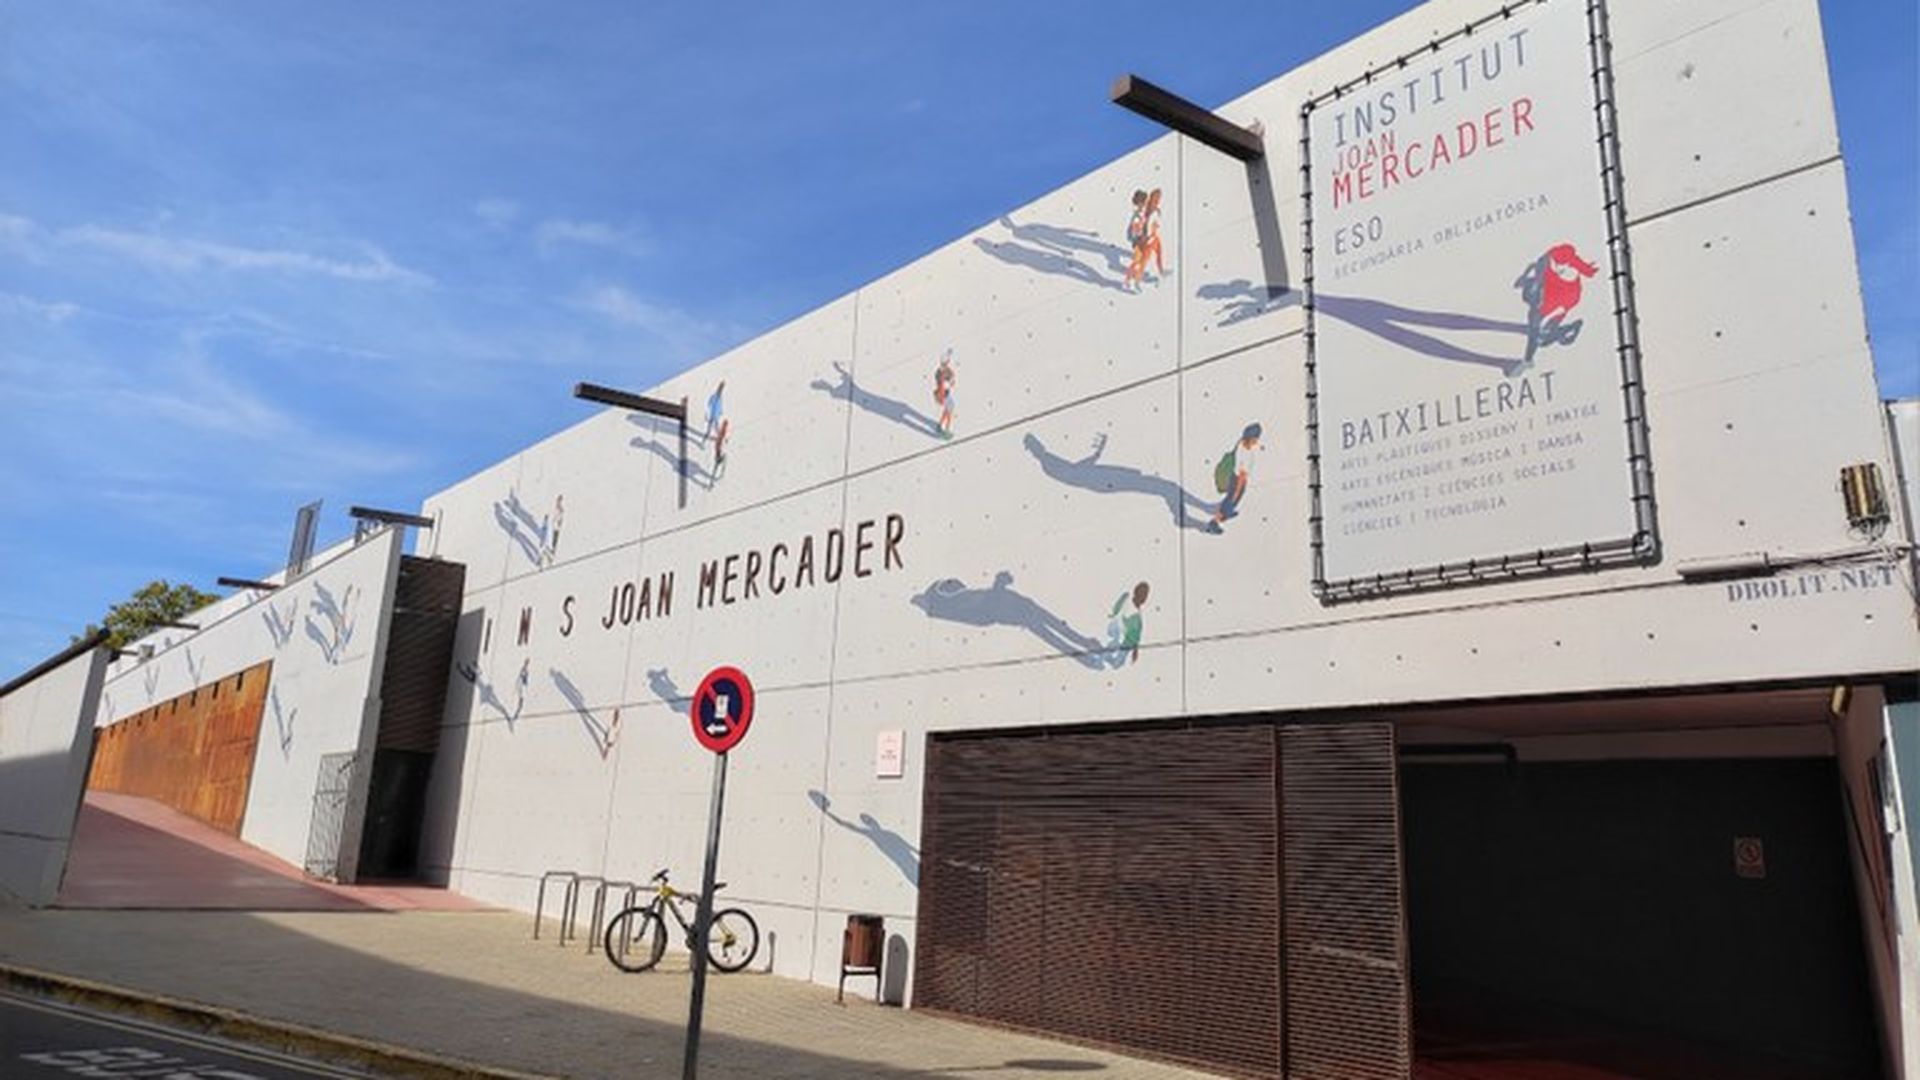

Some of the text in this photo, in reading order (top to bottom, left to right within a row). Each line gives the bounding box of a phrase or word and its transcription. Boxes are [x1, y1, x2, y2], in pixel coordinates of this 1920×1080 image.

[1334, 29, 1529, 148] INSTITUT
[1332, 129, 1395, 175] JOAN
[1333, 98, 1535, 209] MERCADER
[1334, 215, 1383, 255] ESO
[1342, 371, 1555, 450] BATXILLERAT
[1514, 458, 1576, 481] SOCIALS
[602, 571, 675, 631] JOAN
[696, 513, 905, 610] MERCADER
[1726, 564, 1896, 602] DBOLIT.NET
